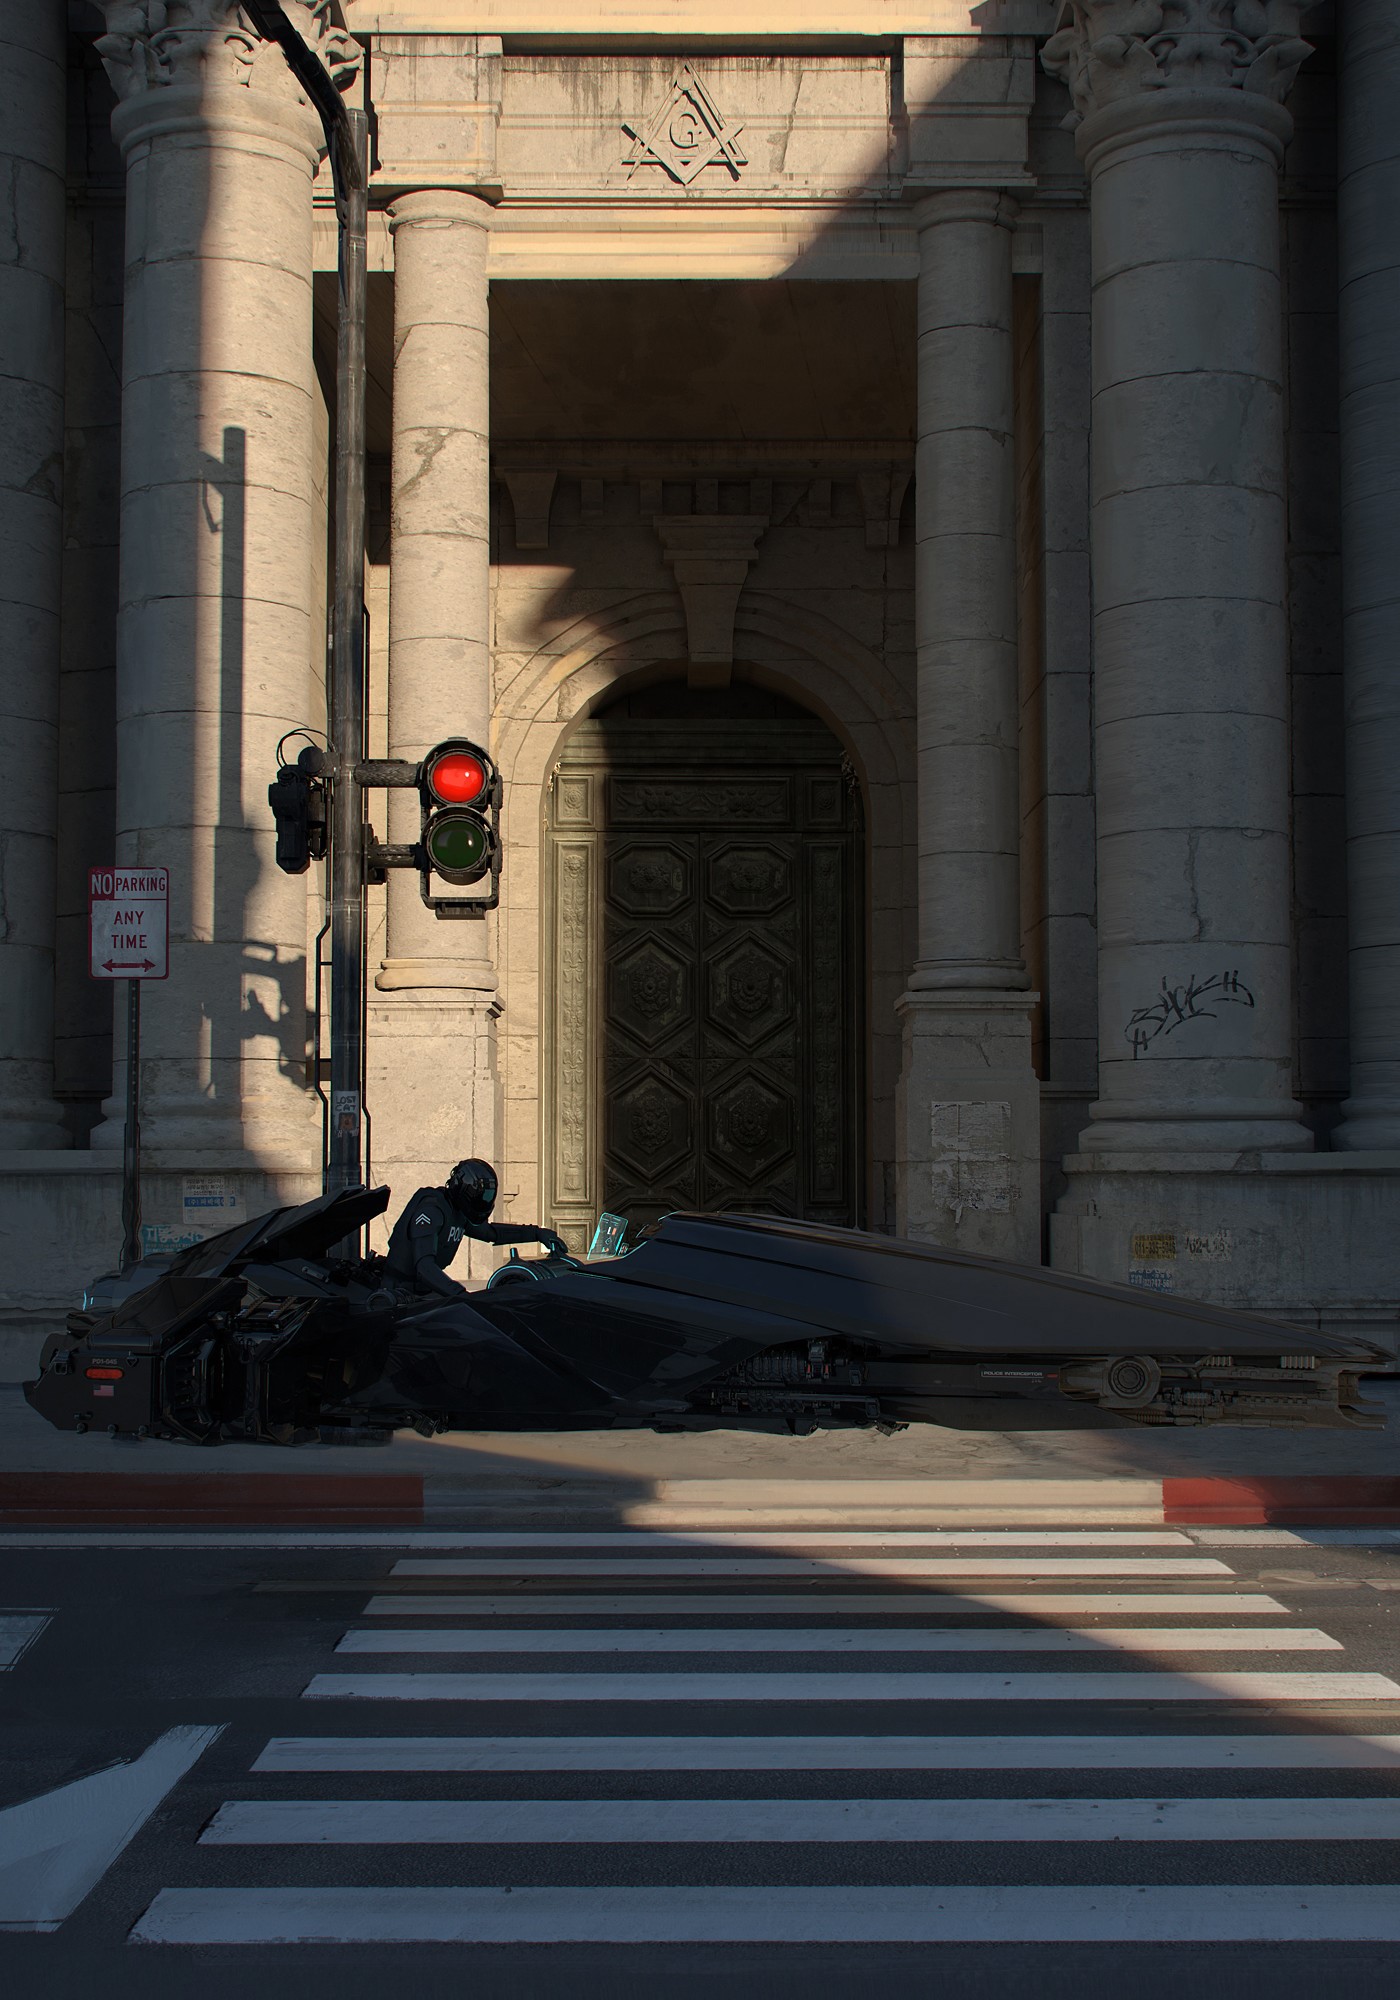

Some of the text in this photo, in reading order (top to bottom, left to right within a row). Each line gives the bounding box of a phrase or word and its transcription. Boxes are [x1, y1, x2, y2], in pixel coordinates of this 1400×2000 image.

[669, 113, 701, 148] G
[92, 873, 166, 895] NO PARKING
[113, 911, 144, 925] ANY
[111, 934, 147, 948] TIME
[336, 1095, 356, 1104] LOST
